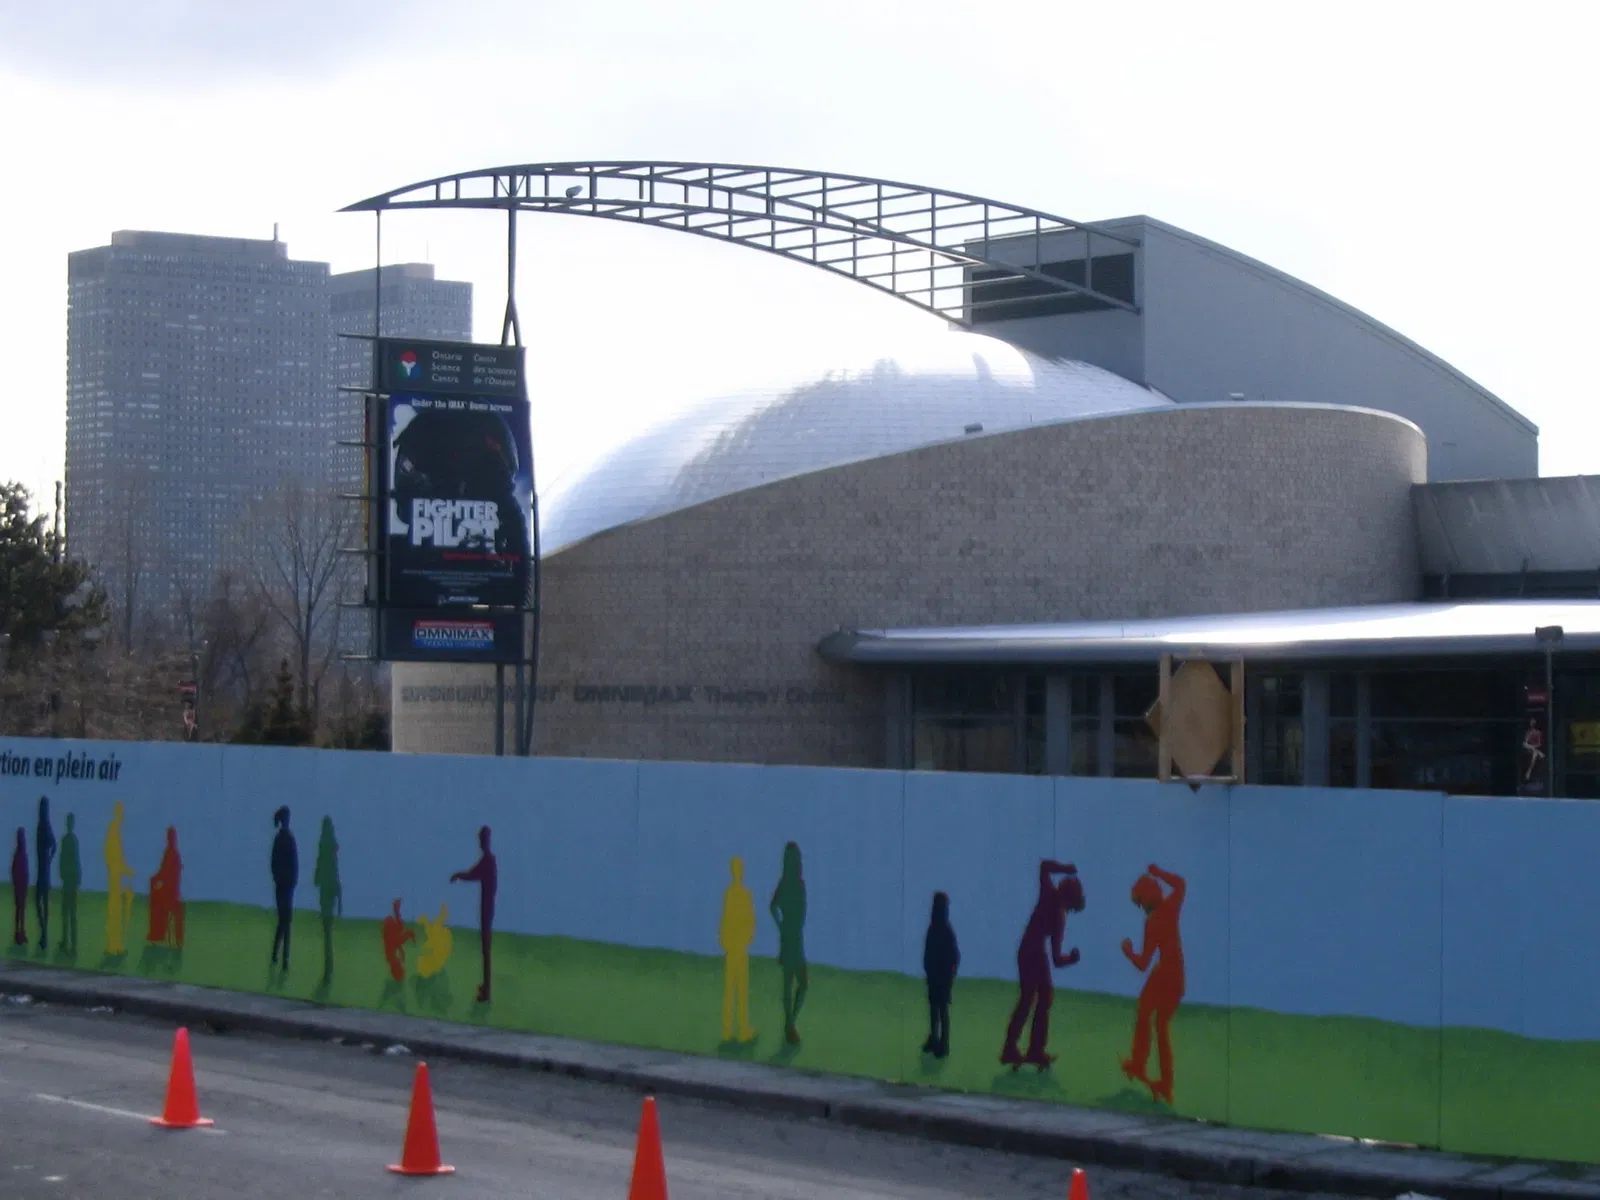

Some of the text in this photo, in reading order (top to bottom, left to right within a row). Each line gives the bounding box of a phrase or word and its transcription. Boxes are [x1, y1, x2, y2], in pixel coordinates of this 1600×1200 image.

[432, 351, 462, 361] Ontario
[474, 354, 497, 363] Centre
[432, 362, 461, 372] Science
[432, 374, 459, 384] Centre
[412, 398, 432, 408] Under
[435, 400, 447, 408] the
[412, 498, 499, 520] FIGHTER
[416, 628, 491, 640] OMNIMAX
[34, 756, 53, 777] en
[56, 749, 95, 785] plein
[99, 752, 121, 781] air
